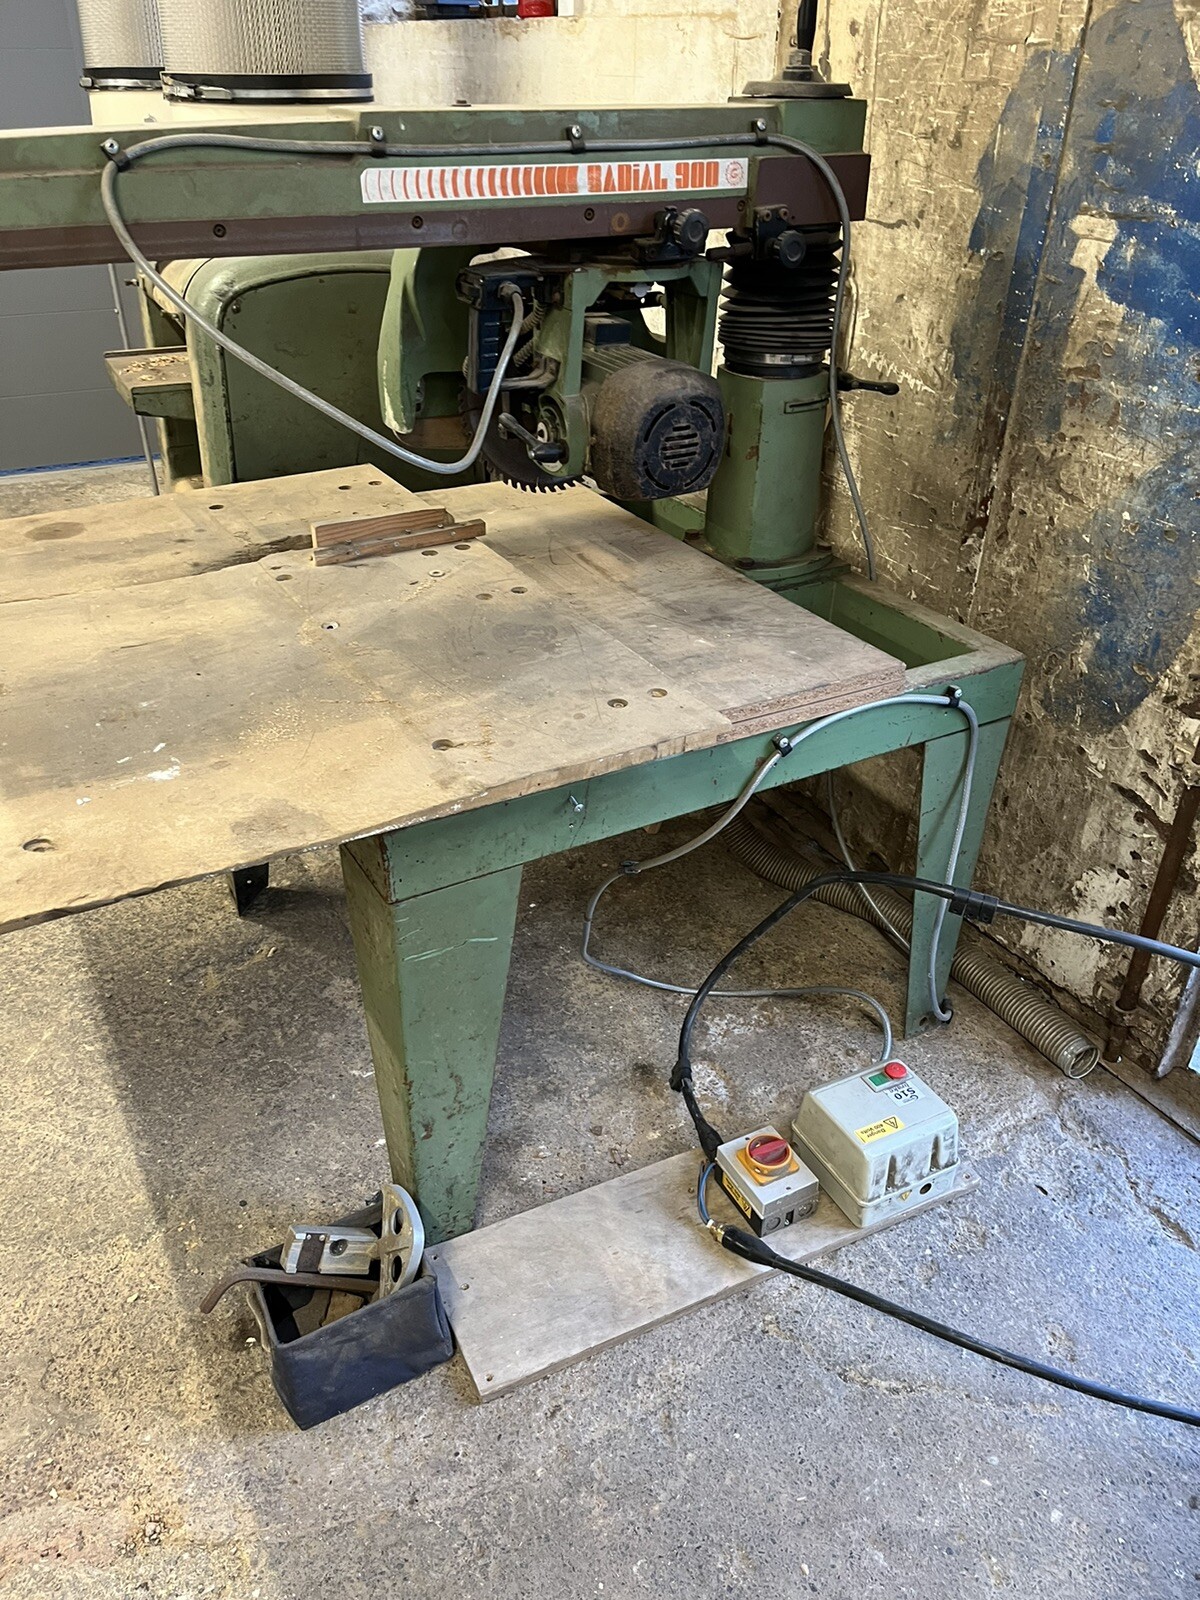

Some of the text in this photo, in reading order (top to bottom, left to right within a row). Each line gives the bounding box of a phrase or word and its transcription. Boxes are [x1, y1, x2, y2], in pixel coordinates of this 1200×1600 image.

[675, 161, 720, 189] 900
[894, 1087, 916, 1100] S10
[867, 1128, 886, 1138] Danger
